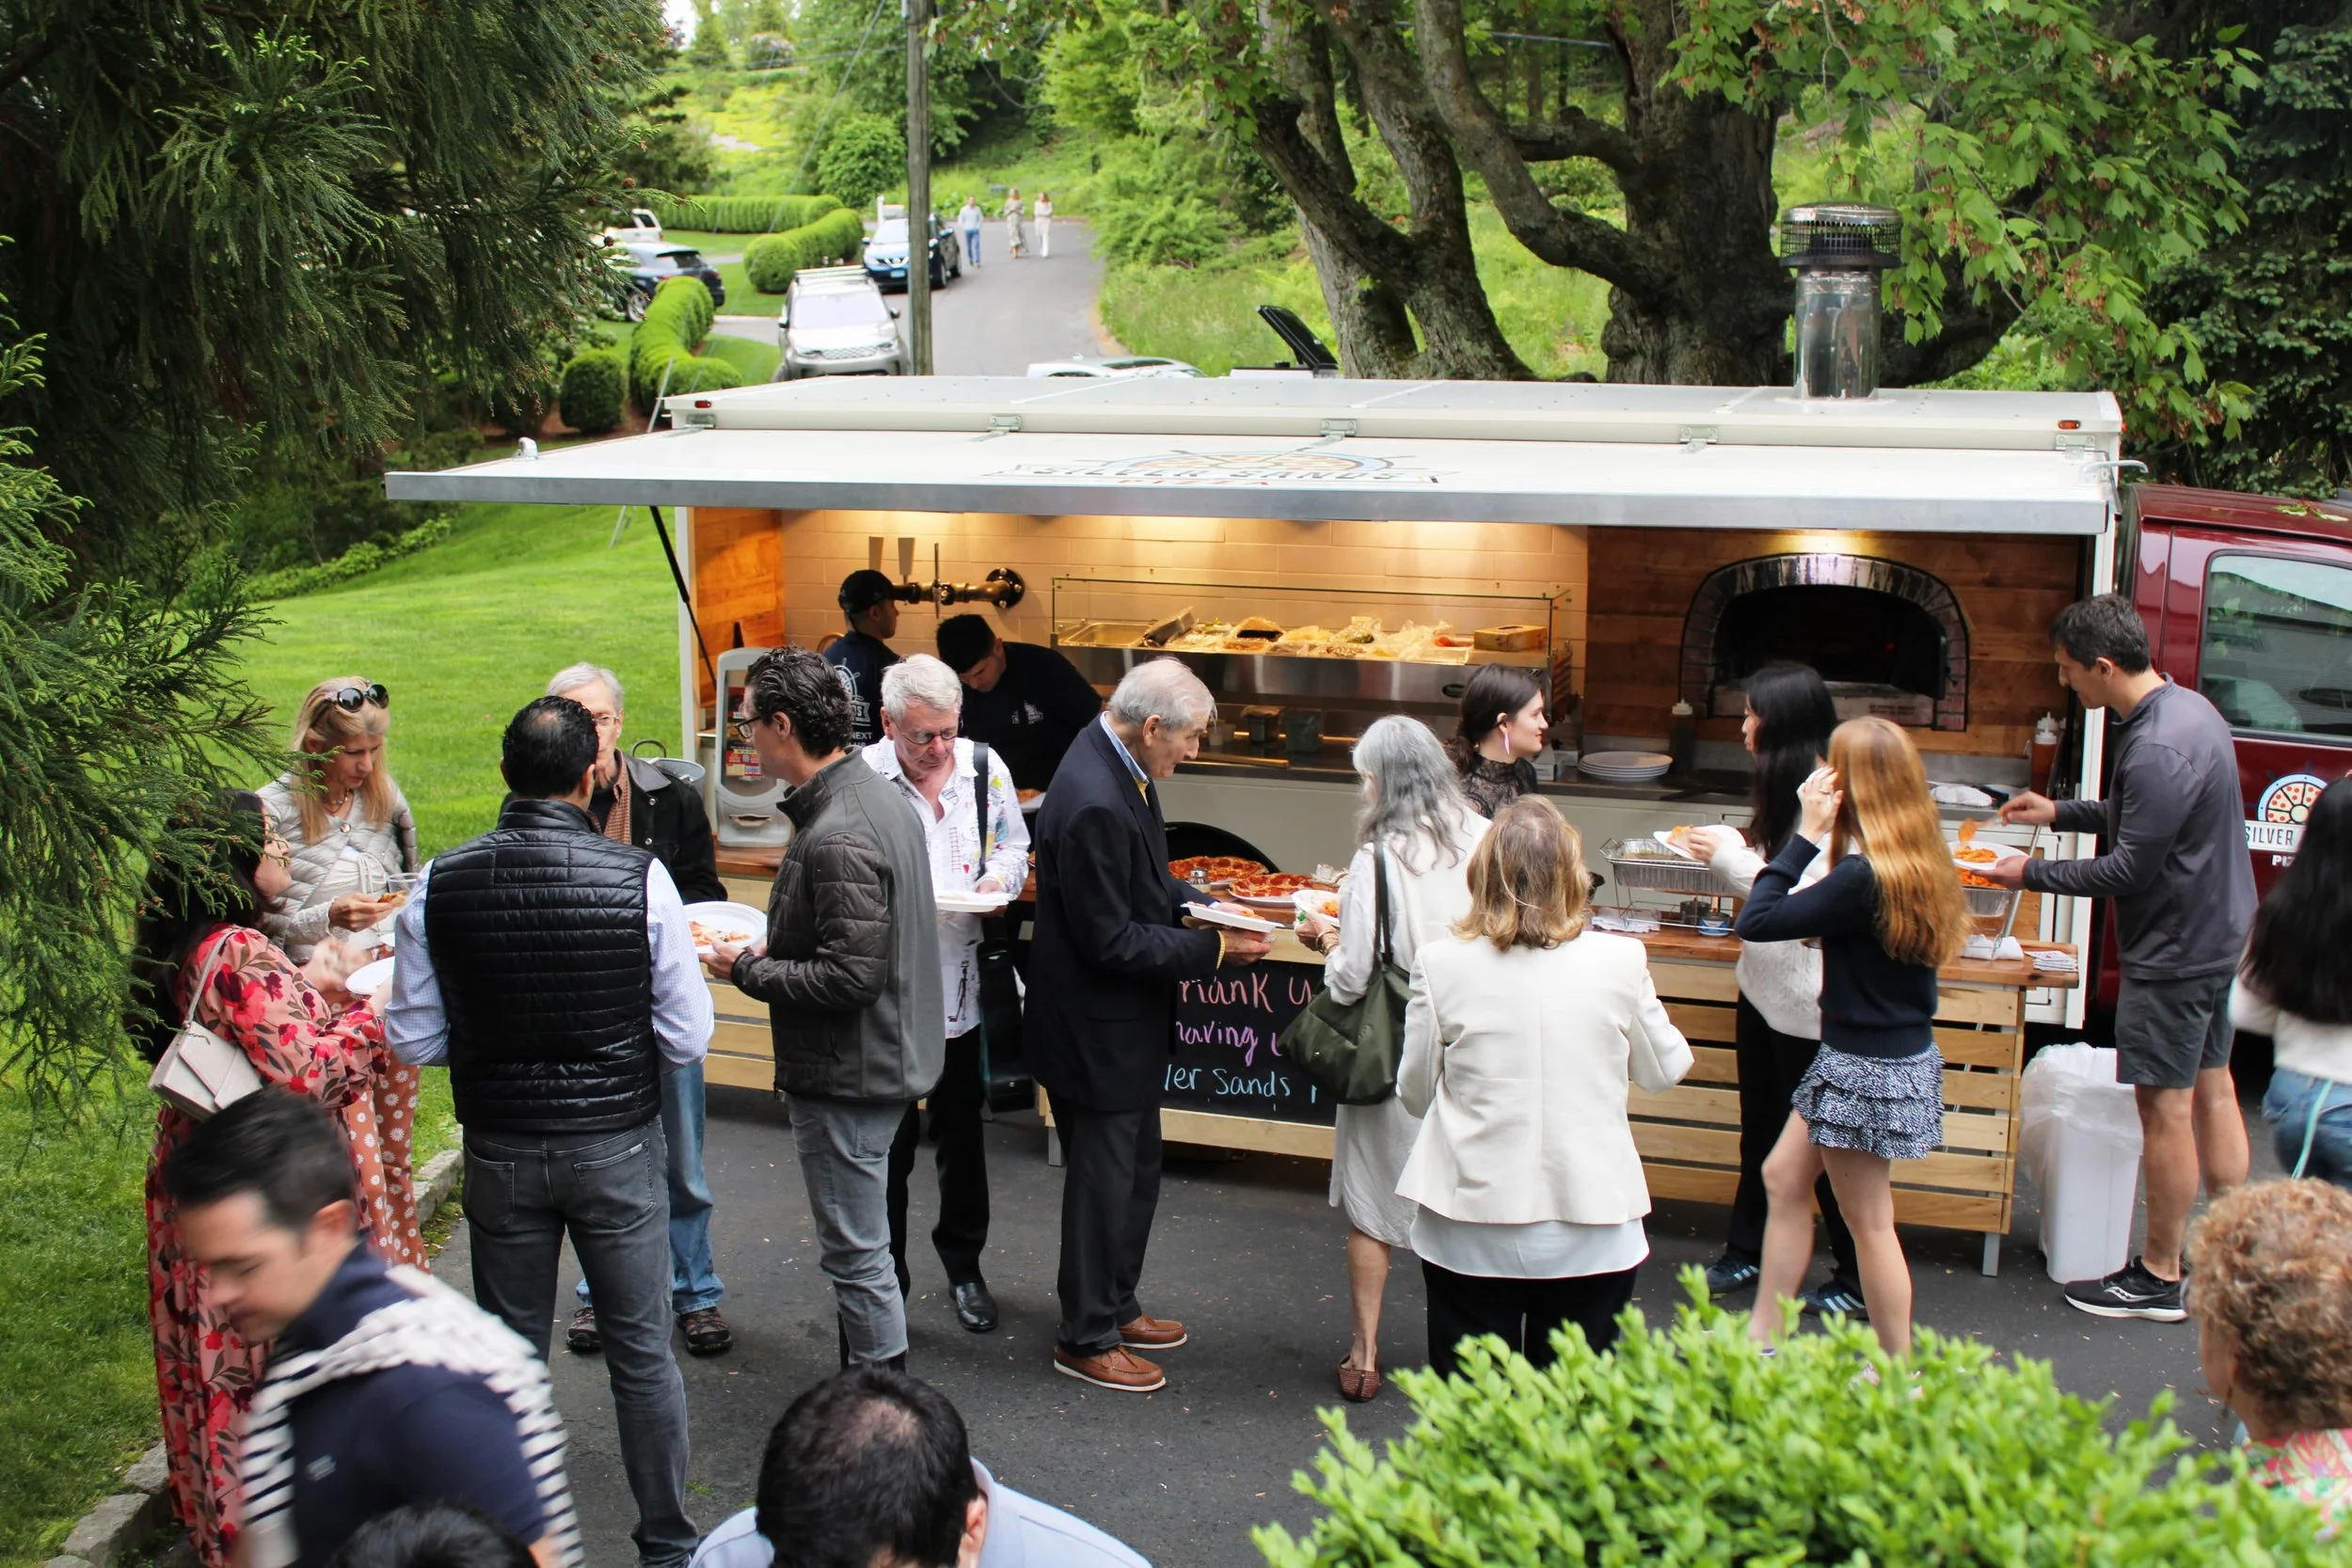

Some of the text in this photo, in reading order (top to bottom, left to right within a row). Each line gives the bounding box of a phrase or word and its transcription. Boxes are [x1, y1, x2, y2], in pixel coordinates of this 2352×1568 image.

[1033, 467, 1404, 480] SILVER SANDS
[2245, 826, 2294, 846] SILVER
[2271, 854, 2296, 867] PIZ
[1213, 1069, 1291, 1097] Sands
